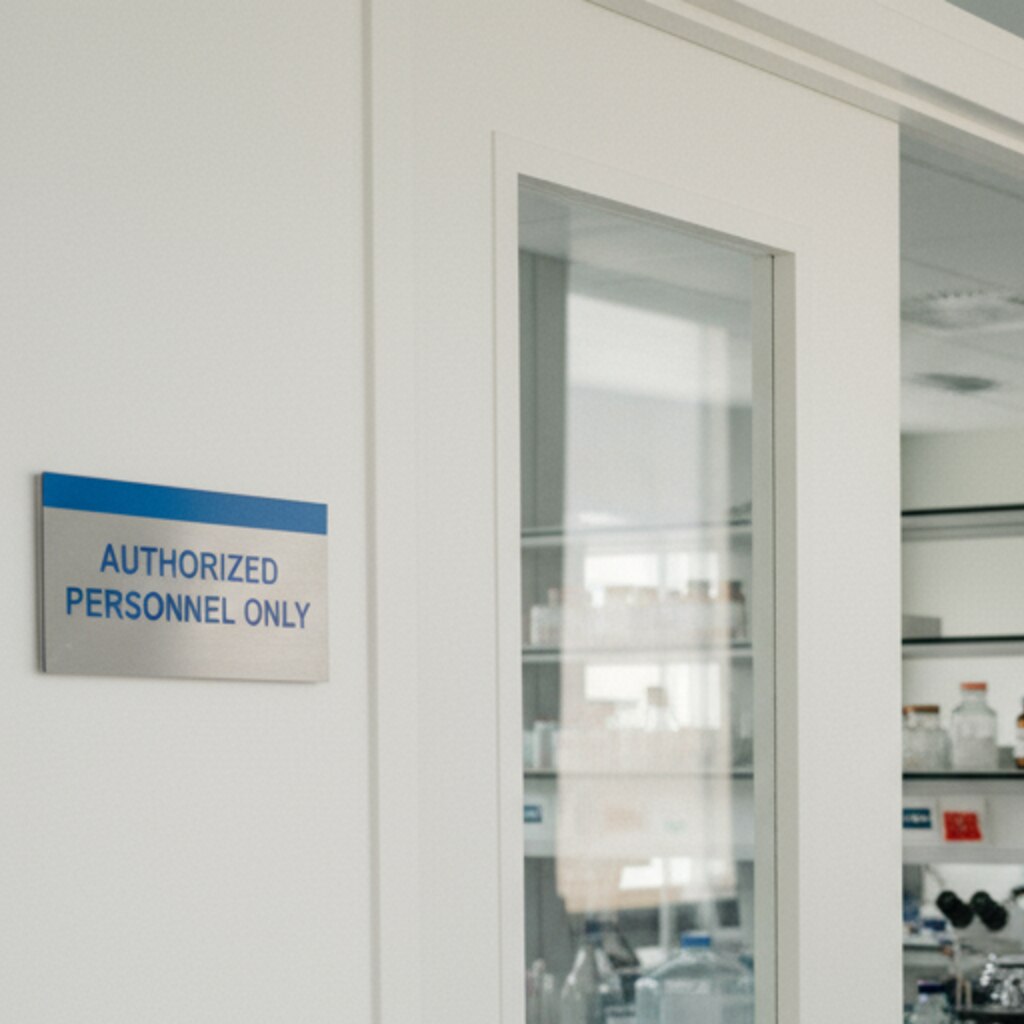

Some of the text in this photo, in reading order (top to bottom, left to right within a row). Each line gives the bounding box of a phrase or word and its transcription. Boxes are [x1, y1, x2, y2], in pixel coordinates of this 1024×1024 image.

[100, 543, 279, 585] AUTHORIZED
[66, 586, 311, 629] PERSONNEL ONLY
